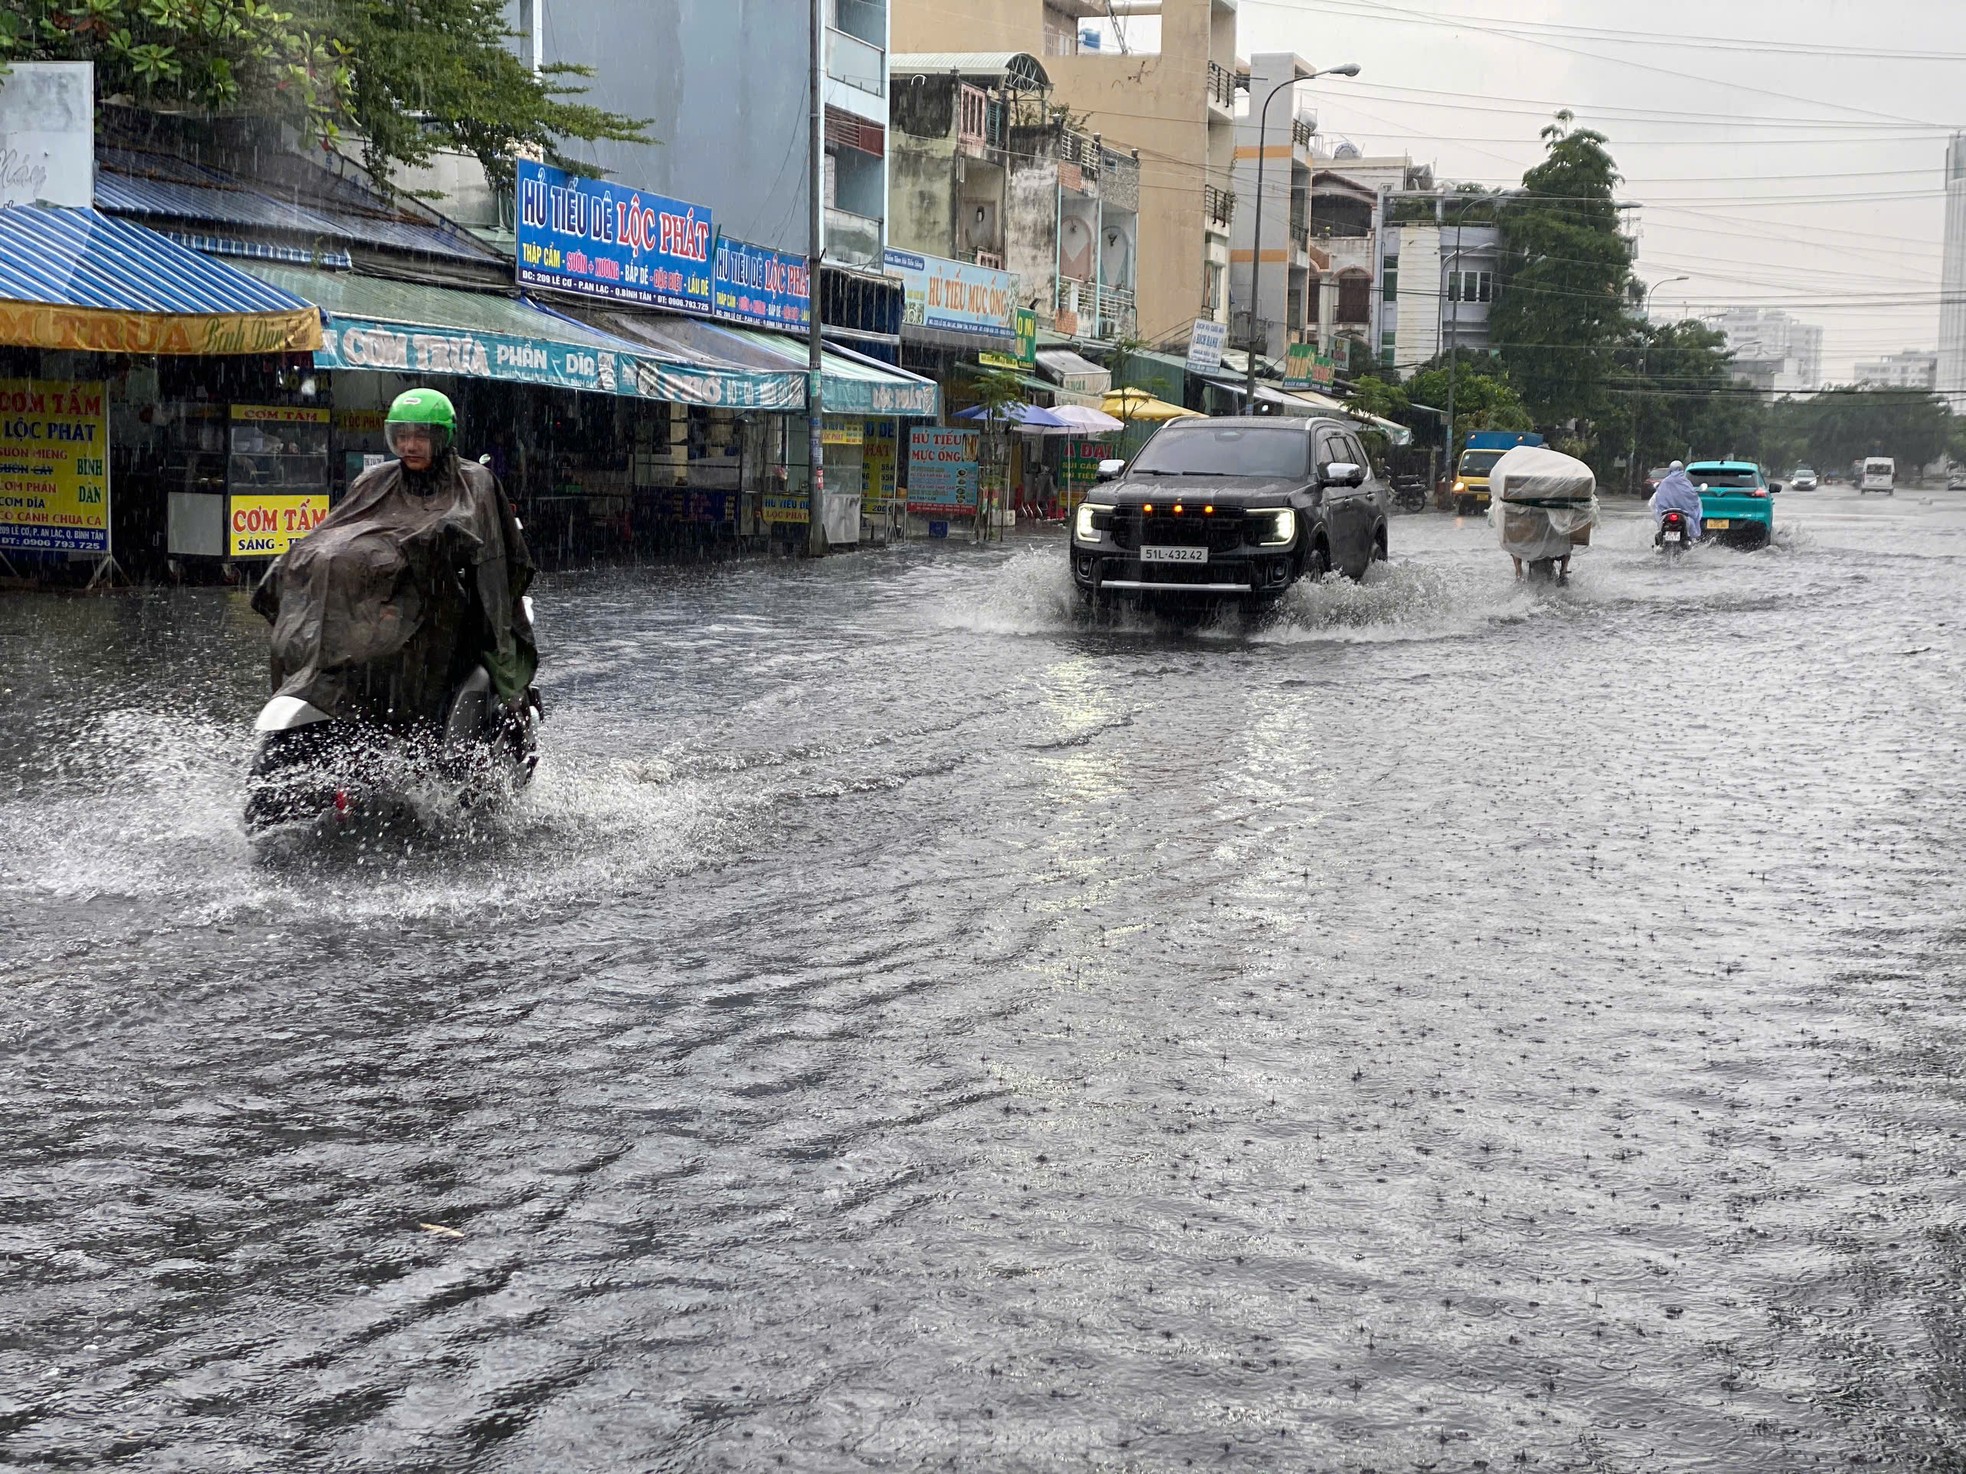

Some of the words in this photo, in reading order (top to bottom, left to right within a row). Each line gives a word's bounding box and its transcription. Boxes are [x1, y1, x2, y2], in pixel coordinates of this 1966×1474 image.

[522, 167, 548, 228] HỦ
[550, 177, 588, 237] TIẾU
[591, 191, 613, 243] DÊ
[616, 193, 656, 258] LỘC
[660, 207, 709, 262] PHÁT
[523, 241, 541, 268] THẬP
[536, 273, 551, 284] 209
[765, 253, 786, 299] LỘC
[928, 265, 943, 307] HỦ
[944, 267, 967, 311] TIẾU
[52, 385, 101, 417] TẤM
[4, 417, 41, 442] LỘC
[47, 420, 96, 441] PHÁT
[912, 430, 930, 445] HỦ
[933, 430, 961, 446] TIẾU
[911, 449, 935, 463] MỰC
[938, 447, 961, 462] ỐNG
[232, 505, 279, 533] CƠM
[284, 498, 327, 533] TẤM
[23, 538, 51, 547] 0906
[54, 540, 76, 549] 793
[79, 541, 100, 550] 725
[238, 536, 275, 551] SÁNG
